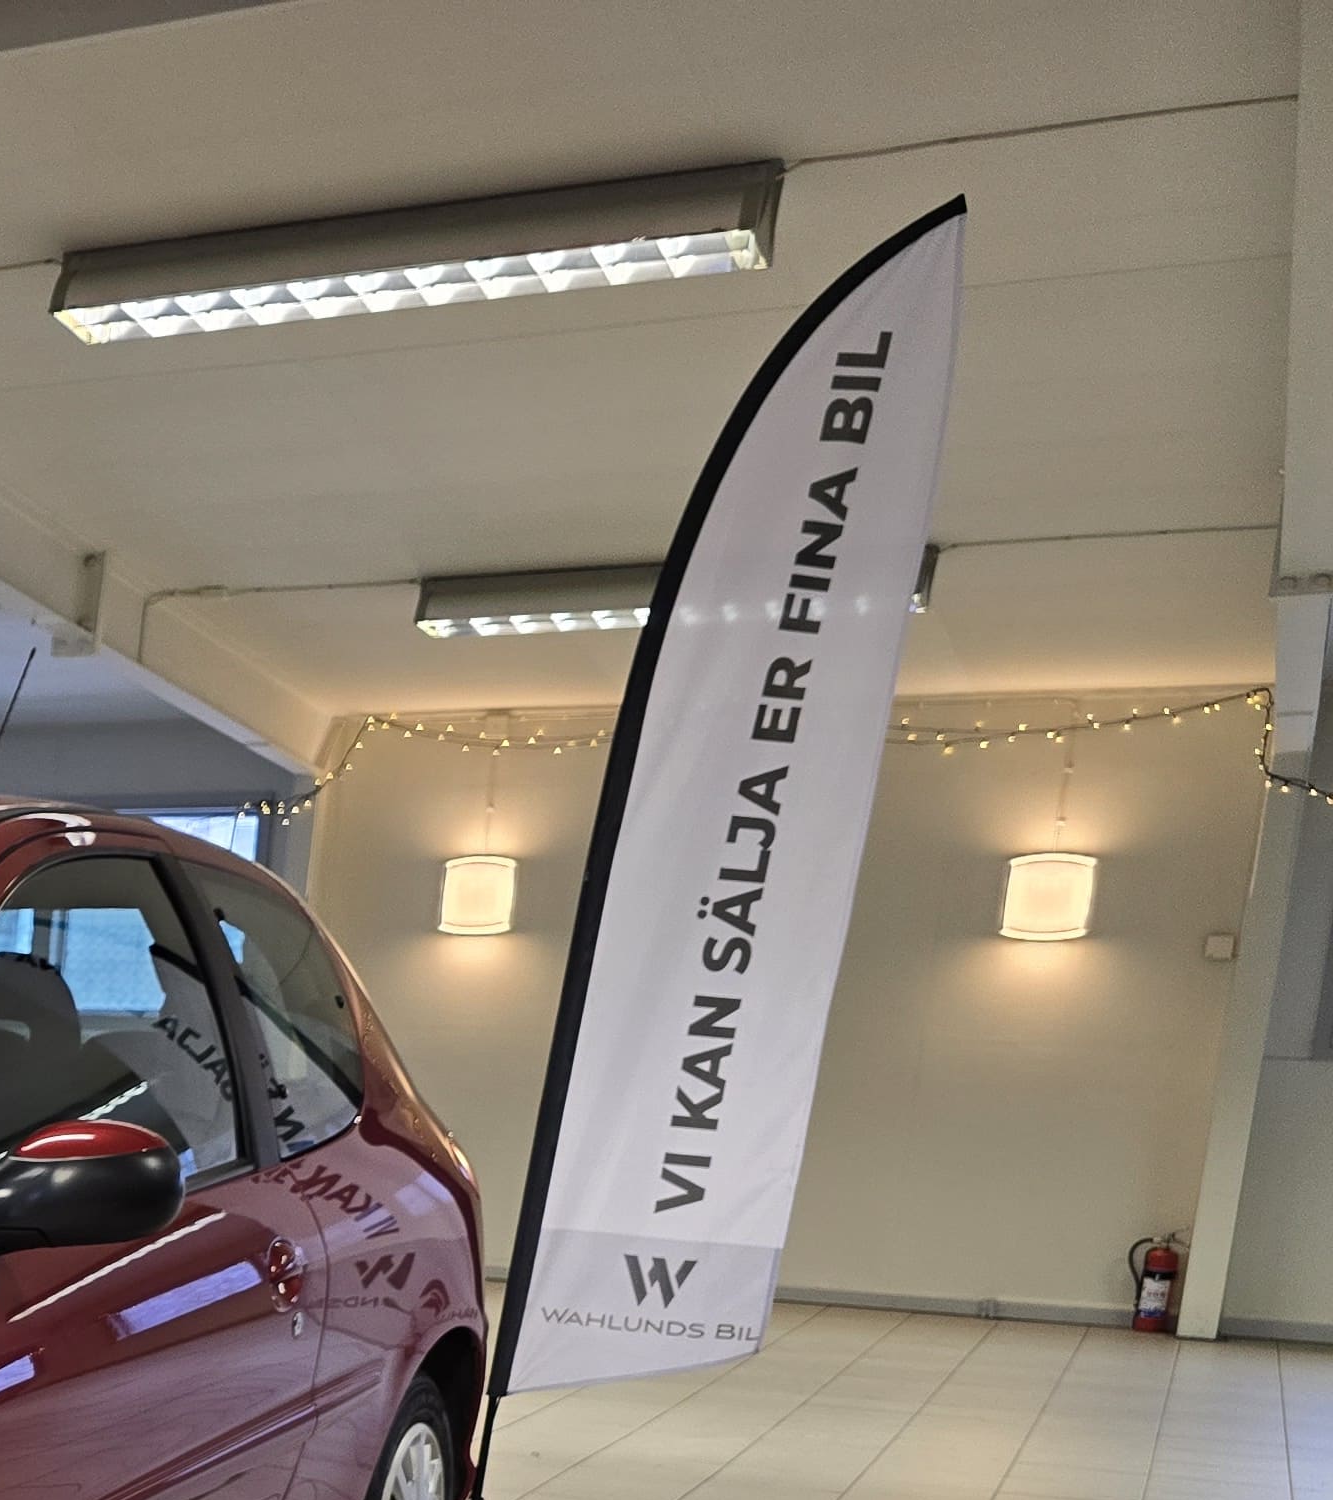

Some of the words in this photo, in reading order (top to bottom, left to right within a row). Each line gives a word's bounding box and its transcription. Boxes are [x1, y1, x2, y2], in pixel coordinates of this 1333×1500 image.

[818, 330, 893, 445] BIL
[777, 466, 859, 635] FINA
[750, 656, 814, 744] ER
[696, 764, 790, 975] SÄLJA
[669, 994, 743, 1132] KAN
[653, 1152, 712, 1214] VI
[540, 1306, 705, 1339] WAHLUNDS
[715, 1322, 761, 1343] BIL
